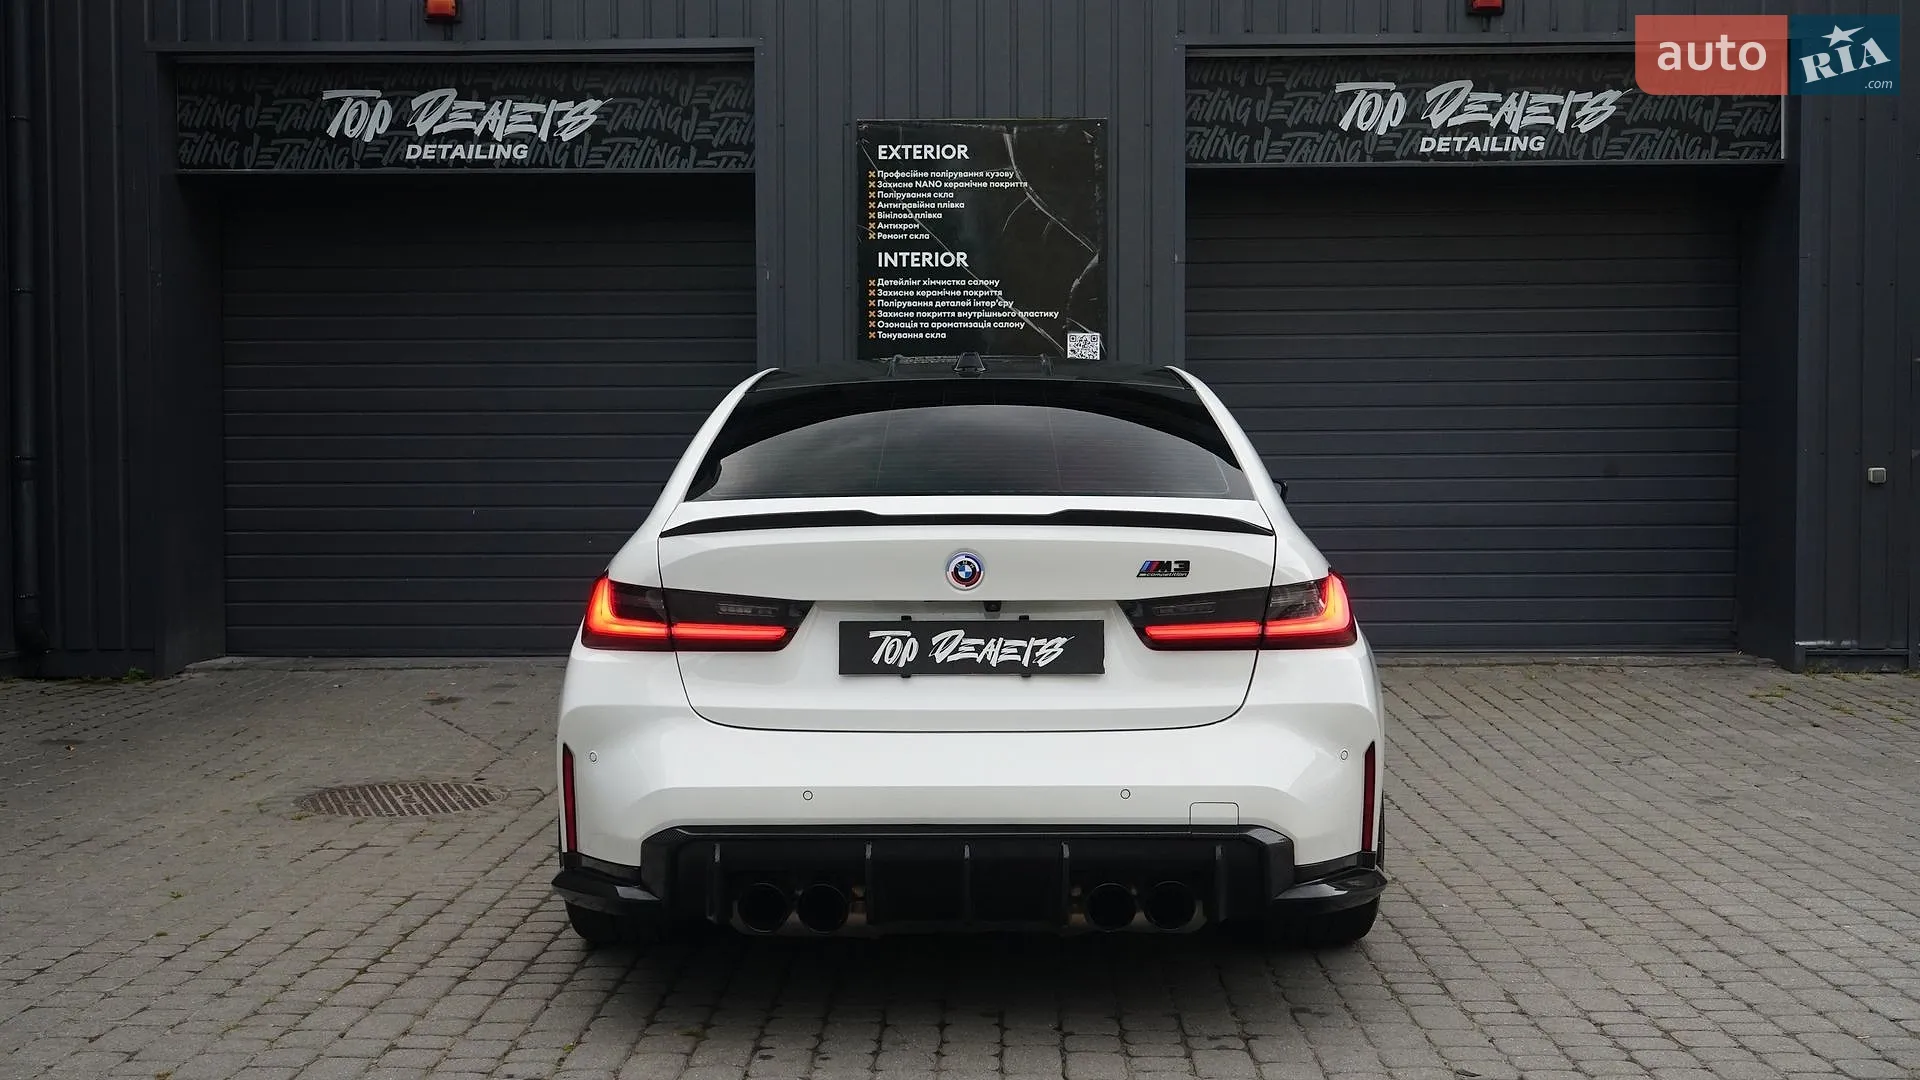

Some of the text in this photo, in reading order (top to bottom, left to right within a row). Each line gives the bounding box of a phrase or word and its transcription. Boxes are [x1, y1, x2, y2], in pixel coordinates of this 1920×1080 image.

[1419, 136, 1546, 152] DETAILING
[405, 144, 529, 160] DETAILING
[877, 144, 970, 160] EXTERIOR
[877, 170, 1015, 179] Професійне полірування кузову
[877, 180, 1028, 190] Захисне NANO керамічне покриття
[877, 191, 932, 199] Полірування
[877, 201, 965, 210] Антигравійна плівка
[877, 211, 943, 219] Вінілова плівка
[877, 222, 920, 230] Антихром
[877, 232, 908, 240] Ремонт
[877, 252, 969, 268] INTERIOR
[877, 278, 922, 287] Детейлінг
[967, 279, 1000, 287] салону
[877, 289, 1003, 298] Захисне керамічне покриття
[877, 299, 933, 309] Полірування
[934, 299, 972, 308] деталей
[877, 310, 1060, 319] Захисне покриття внутрішнього пластику
[877, 321, 918, 329] Озонація
[930, 321, 992, 329] ароматизація
[993, 321, 1026, 330] салону
[877, 331, 924, 340] Тонування
[1151, 560, 1191, 572] M3
